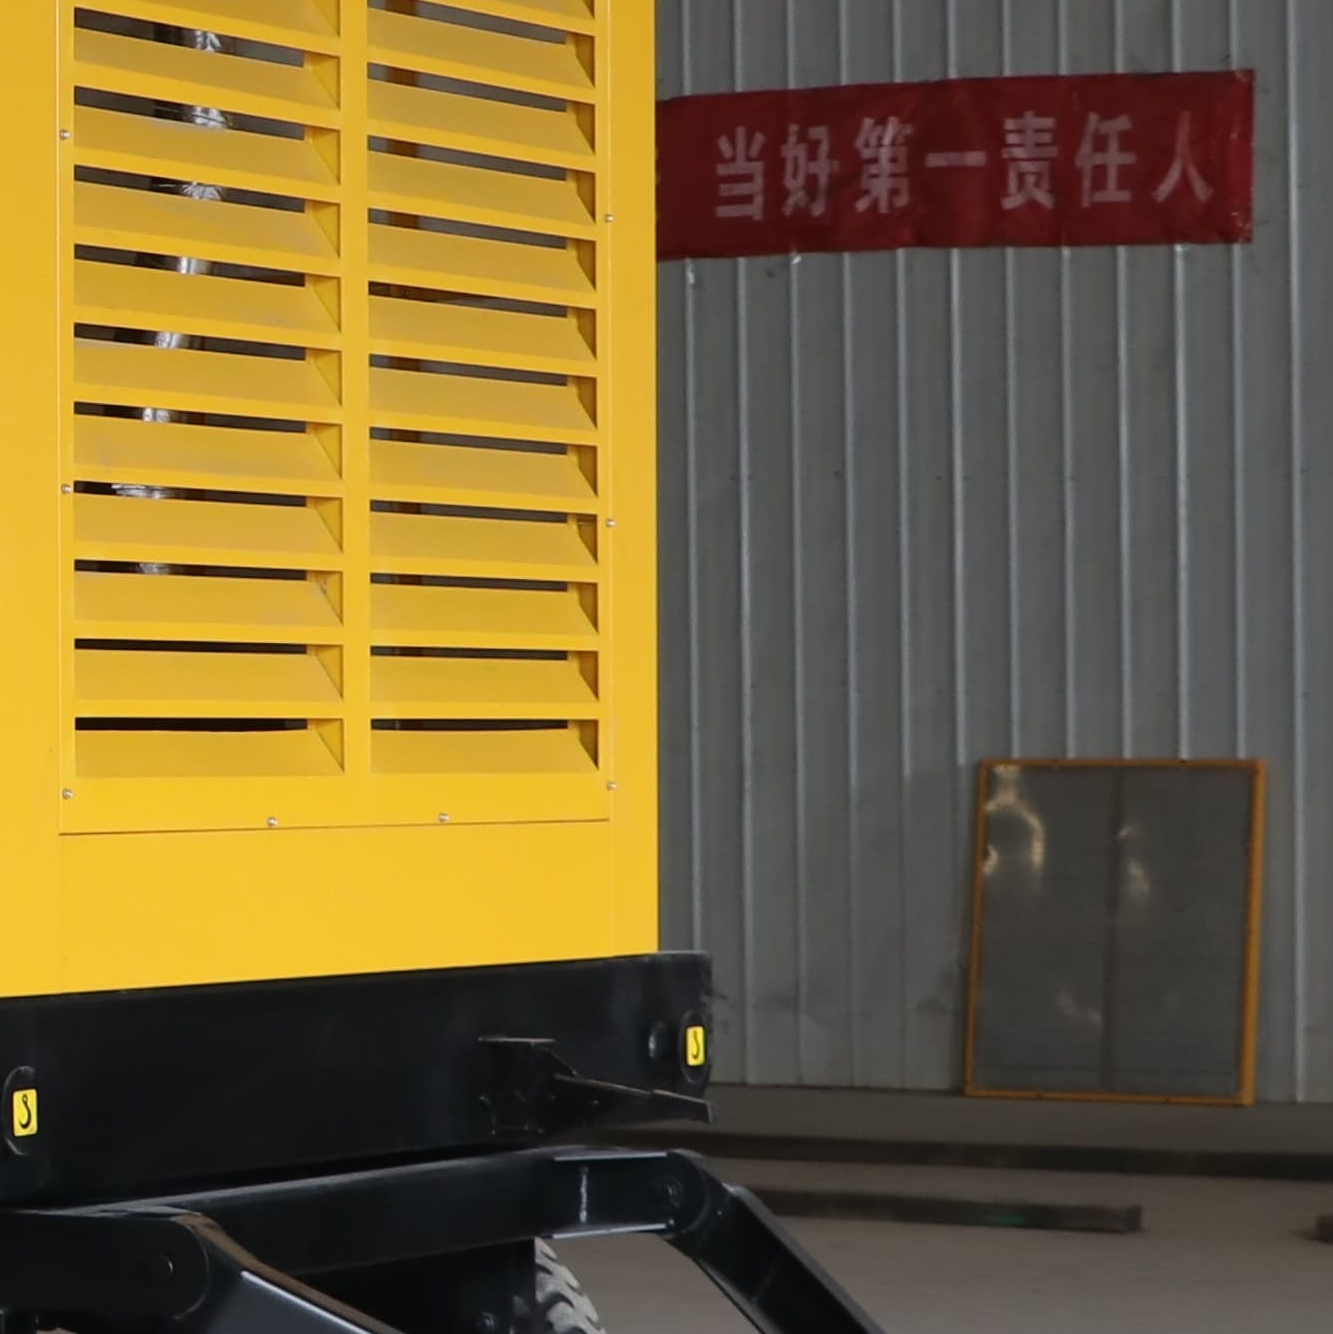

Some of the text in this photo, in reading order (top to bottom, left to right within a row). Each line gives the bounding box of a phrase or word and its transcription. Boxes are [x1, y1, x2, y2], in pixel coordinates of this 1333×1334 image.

[715, 112, 1213, 220] 当好第一责任人
